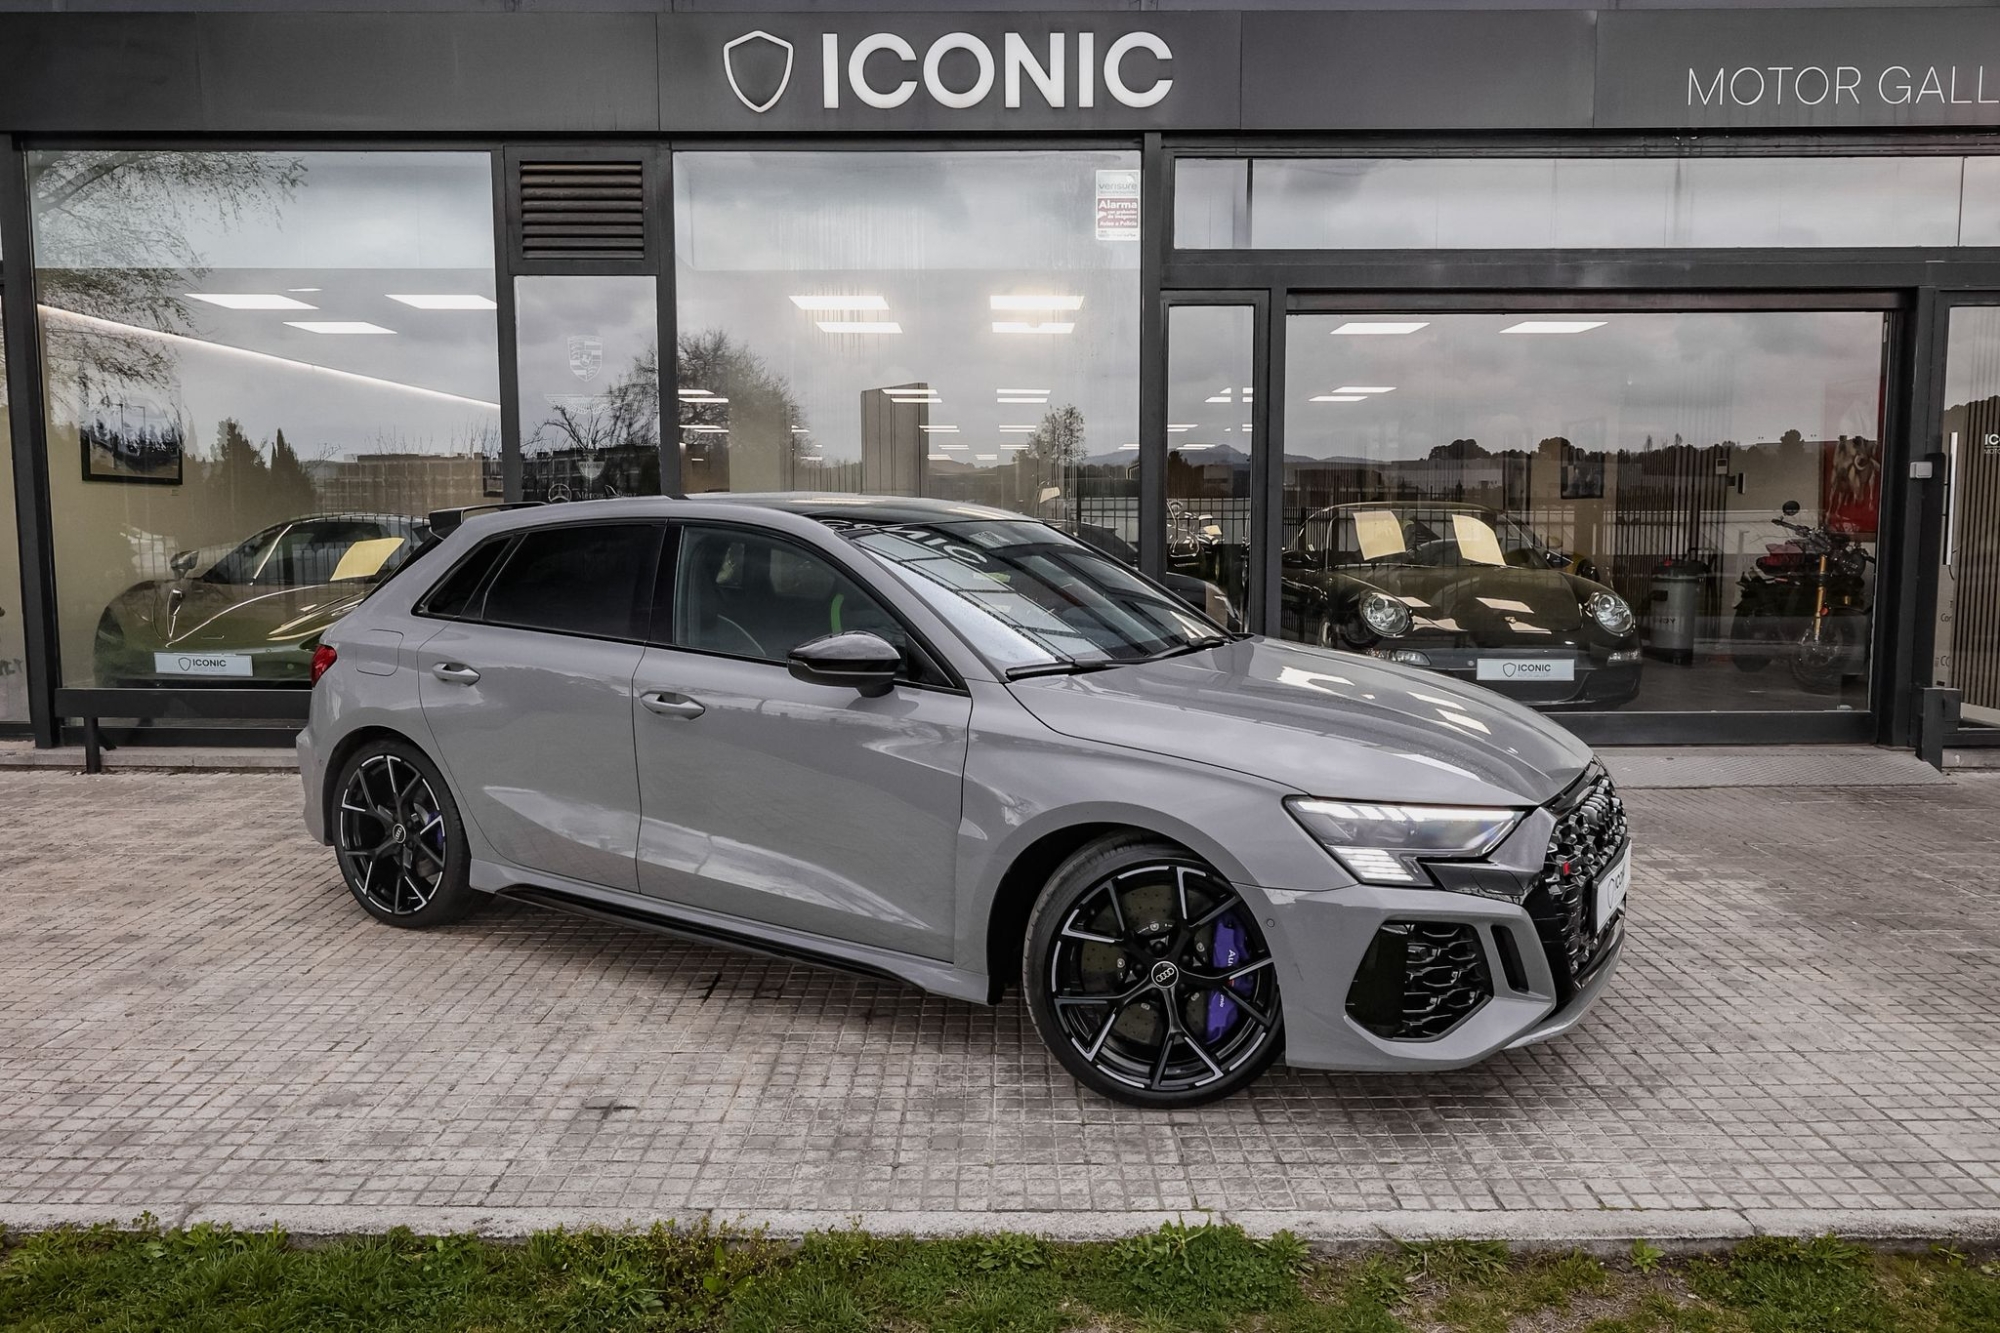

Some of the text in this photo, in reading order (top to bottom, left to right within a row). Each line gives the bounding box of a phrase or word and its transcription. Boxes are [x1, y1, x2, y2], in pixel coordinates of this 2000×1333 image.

[822, 31, 1173, 108] ICONIC
[1687, 65, 2000, 105] MOTOR GALL
[1099, 200, 1137, 209] Alarma
[1984, 433, 2000, 446] IC
[192, 659, 227, 667] ICONIC
[1518, 664, 1551, 672] ICONIC
